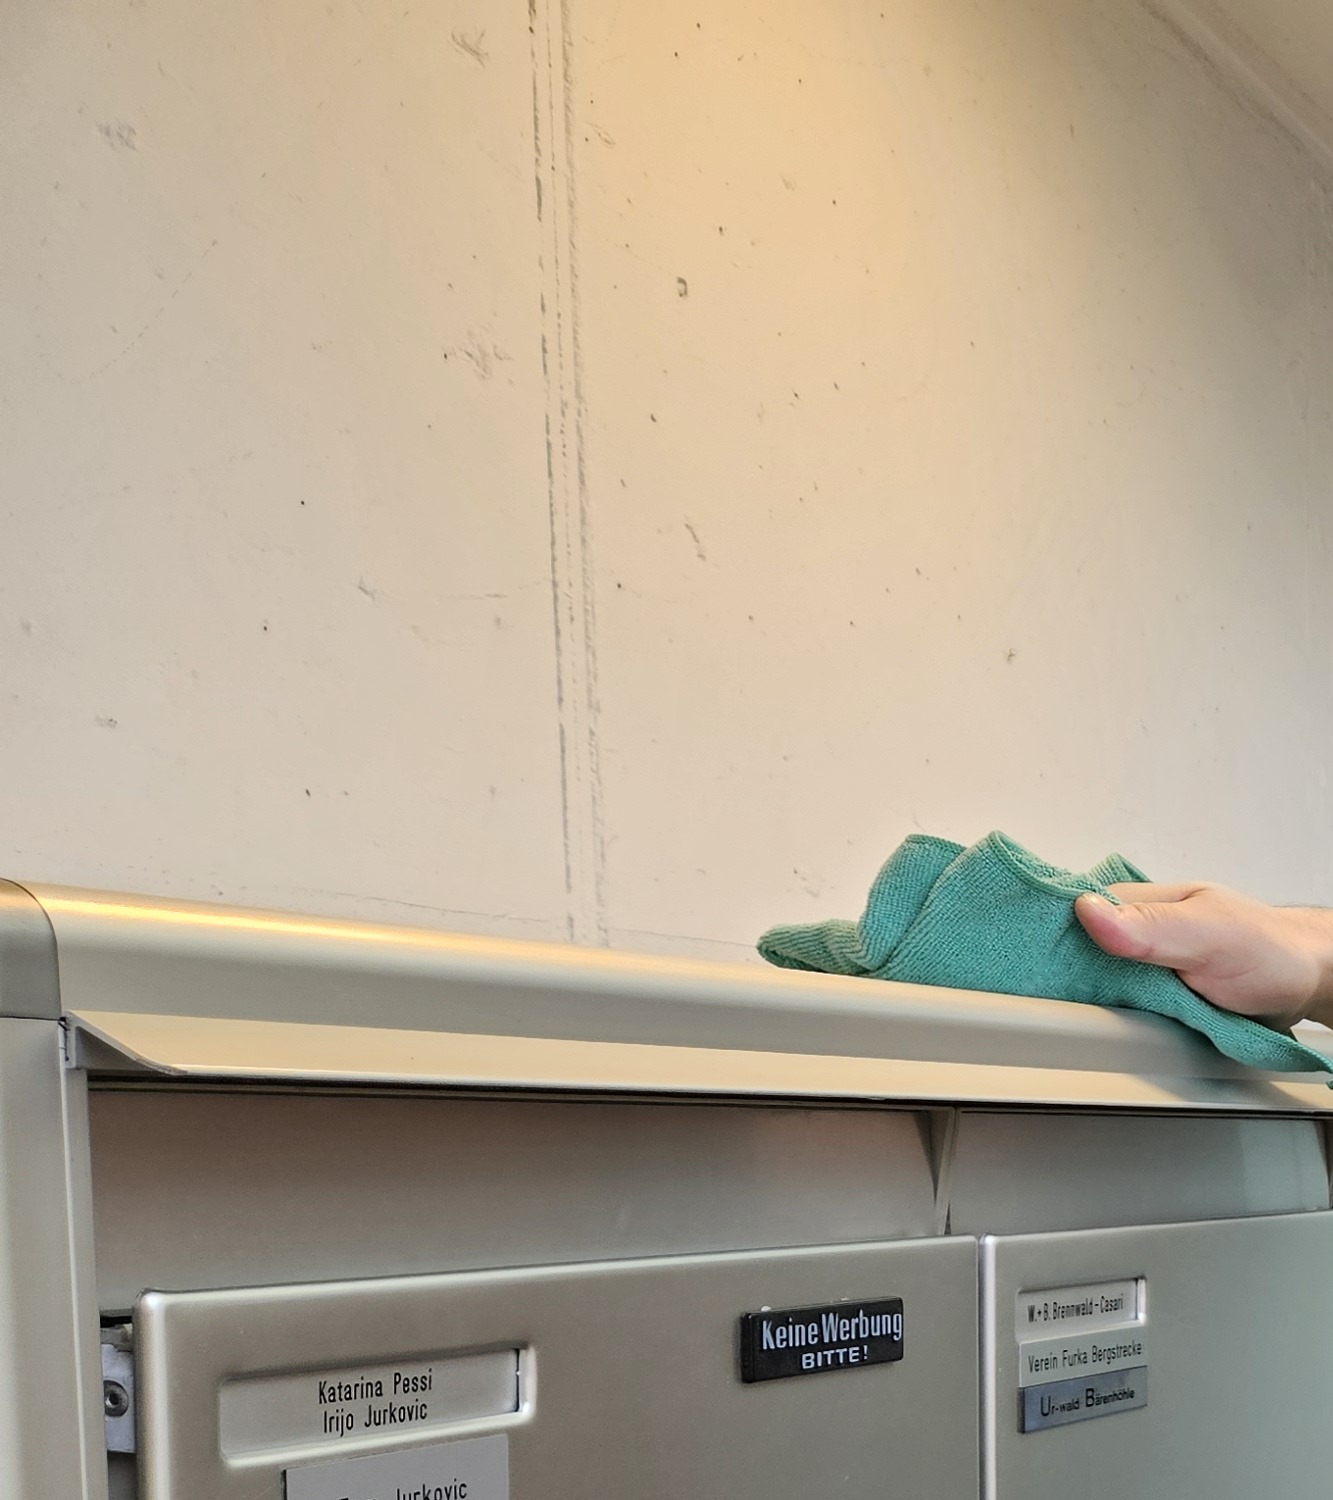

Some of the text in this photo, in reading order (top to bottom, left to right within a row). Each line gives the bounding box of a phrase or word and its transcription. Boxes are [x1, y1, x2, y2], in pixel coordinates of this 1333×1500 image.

[762, 1309, 903, 1350] Keine Werbung
[801, 1345, 868, 1370] BITTE!
[1028, 1340, 1142, 1373] Verein Furka Bergstrecke
[318, 1368, 433, 1405] Katarina Pessi
[323, 1398, 428, 1437] Irijo Jurkovic
